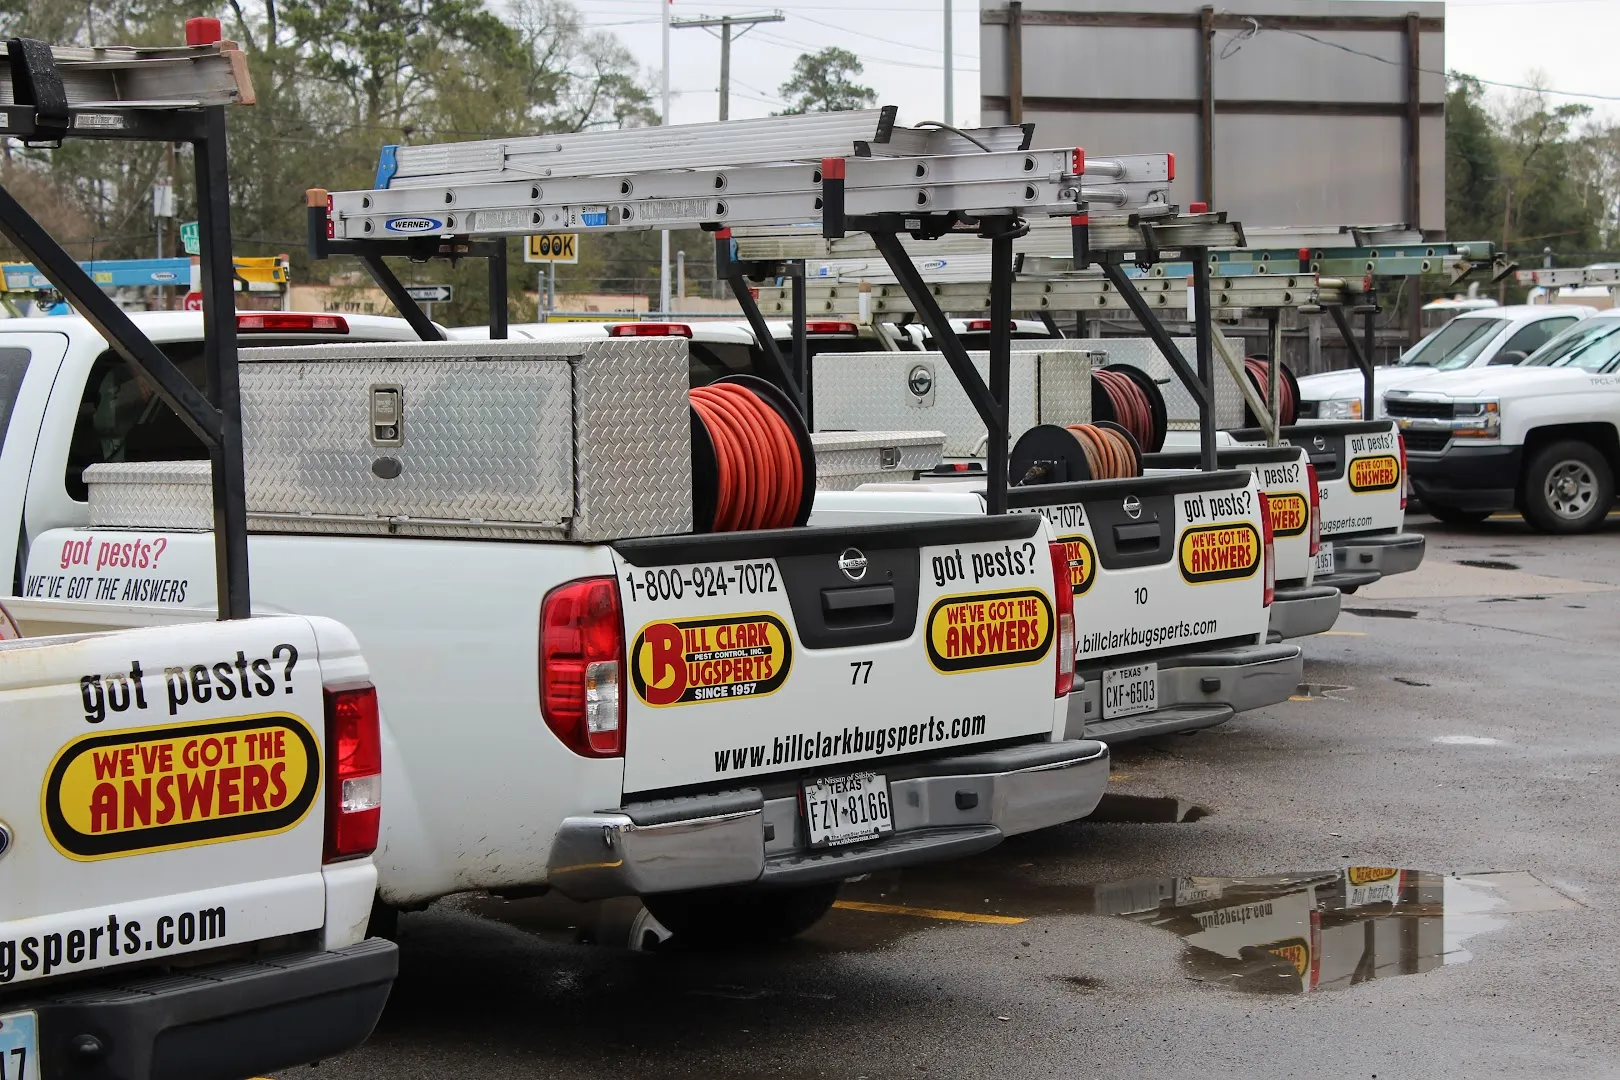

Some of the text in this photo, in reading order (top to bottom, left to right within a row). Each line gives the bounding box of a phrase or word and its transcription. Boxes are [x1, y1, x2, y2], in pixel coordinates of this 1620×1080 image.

[530, 235, 573, 256] LOOK
[1351, 433, 1394, 454] got pests?
[1264, 463, 1299, 488] pests?
[1372, 460, 1384, 469] GOT
[1385, 459, 1393, 468] THE
[1356, 469, 1394, 486] ANSWERS
[1184, 490, 1251, 523] got pests?
[1272, 499, 1287, 510] GOT
[1288, 498, 1300, 510] THE
[1191, 529, 1250, 549] WE'VE GOT THE
[60, 536, 168, 571] got pests?
[932, 542, 1036, 587] got pests?
[1191, 545, 1252, 573] ANSWERS
[26, 575, 188, 603] WE'VE GOT THE ANSWERS
[626, 562, 778, 602] 1-800-924-7072
[1134, 586, 1148, 605] 10
[947, 599, 1038, 625] WE'VE GOT THE
[716, 622, 771, 650] CLARK
[946, 619, 1039, 658] ANSWERS
[694, 648, 765, 661] PEST CONTROL, INC.
[80, 643, 299, 724] got pests?
[850, 661, 873, 685] 77
[1119, 667, 1142, 679] TEXAS
[694, 683, 757, 700] SINCE 1957
[93, 730, 286, 781] WE'VE GOT THE
[714, 714, 986, 773] www.billclarkbugsperts.com
[824, 776, 846, 785] Nissan
[846, 773, 855, 781] of
[829, 780, 862, 795] TEXAS
[89, 761, 288, 833] ANSWERS
[0, 906, 226, 983] gsperts.com
